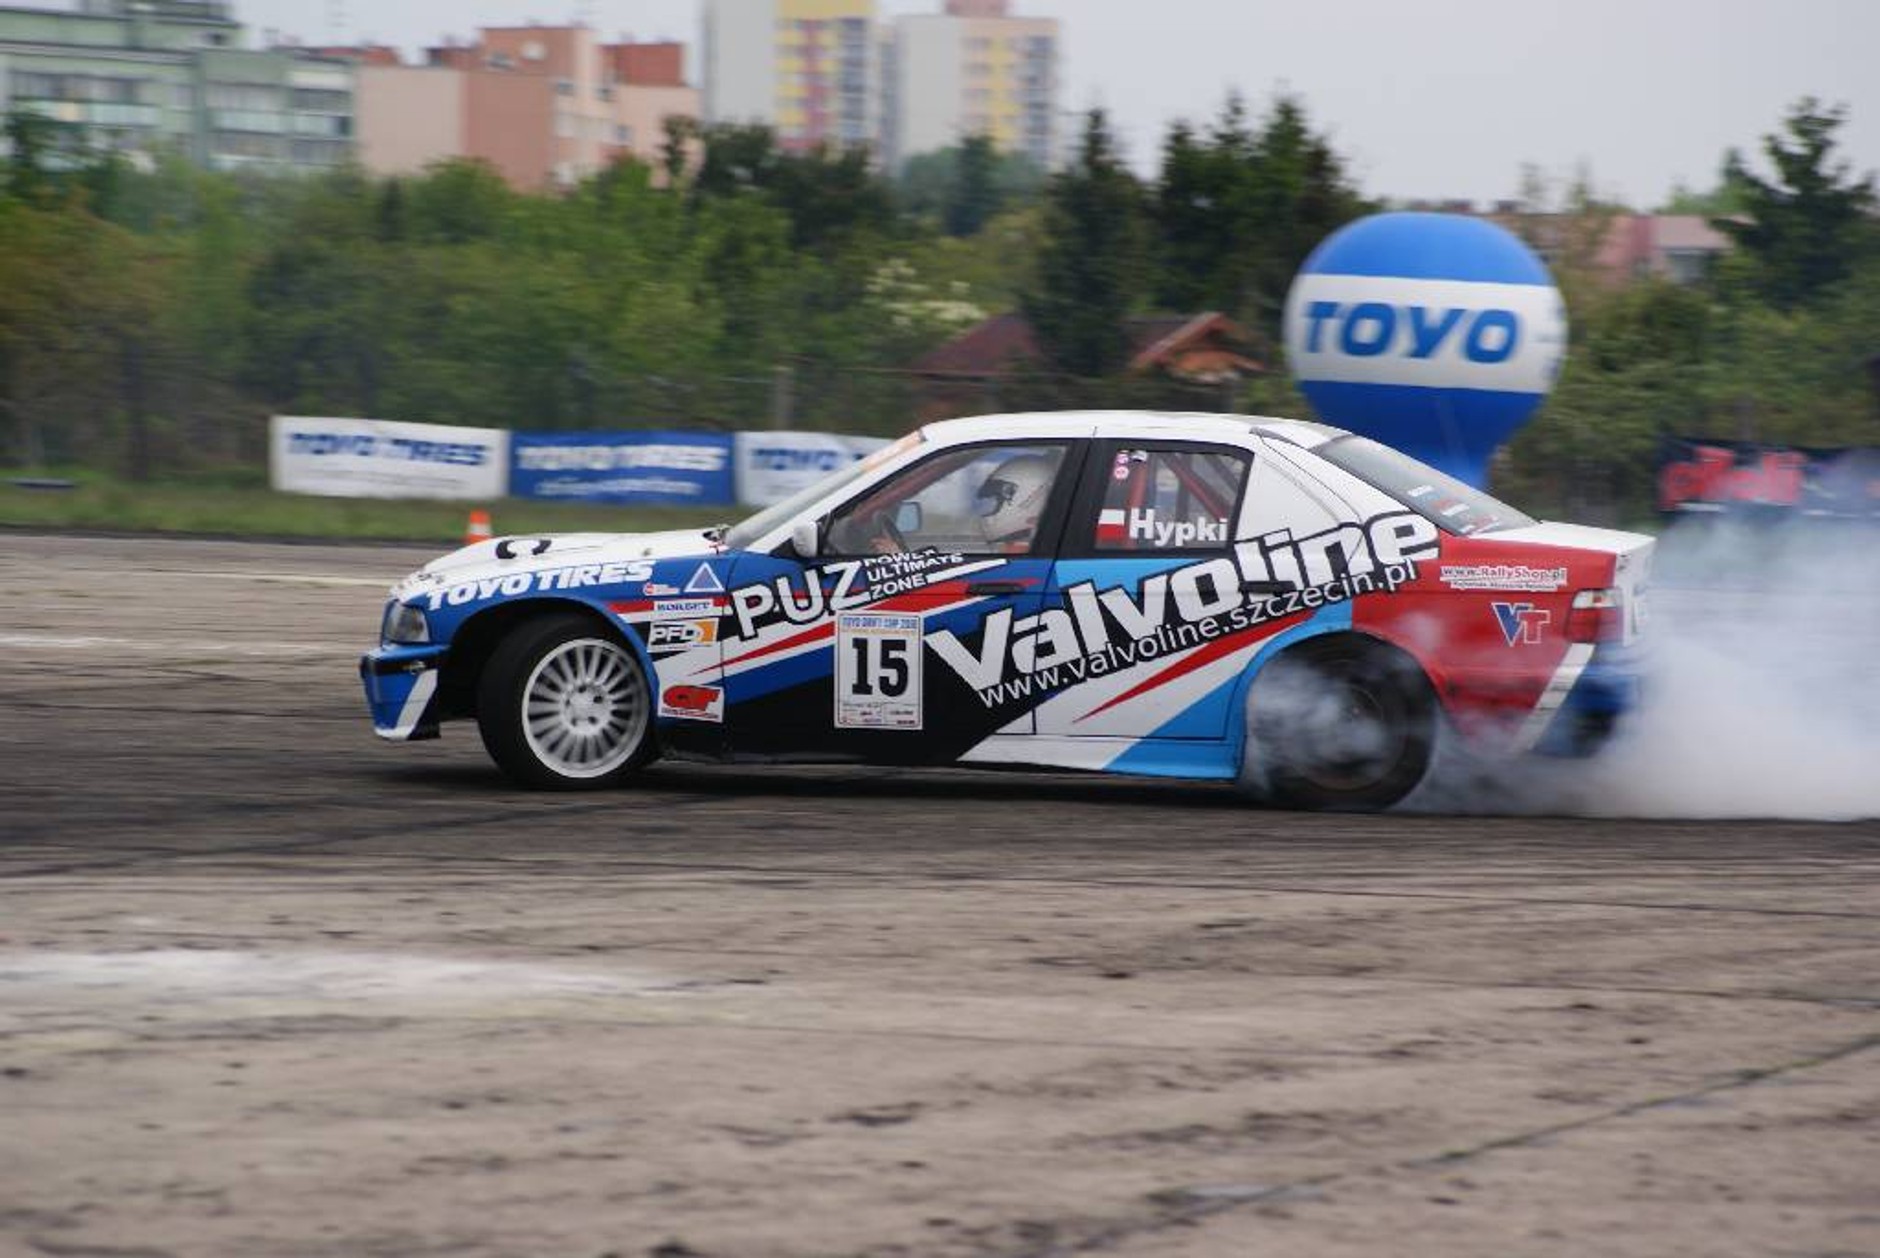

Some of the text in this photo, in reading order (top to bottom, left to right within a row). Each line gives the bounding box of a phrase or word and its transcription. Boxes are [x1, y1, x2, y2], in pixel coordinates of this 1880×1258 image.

[1304, 301, 1520, 363] TOYO
[1128, 508, 1229, 547] Hypki
[427, 560, 657, 611] TOYO TIRES
[867, 552, 964, 582] ULTIMATE
[870, 573, 927, 600] ZONE
[1442, 567, 1566, 582] www.RallyShop.pl
[731, 560, 871, 639] PUZ
[922, 513, 1439, 692] Valvoline
[978, 557, 1417, 710] www.valvoline.szczecin.pl
[851, 637, 909, 697] 15
